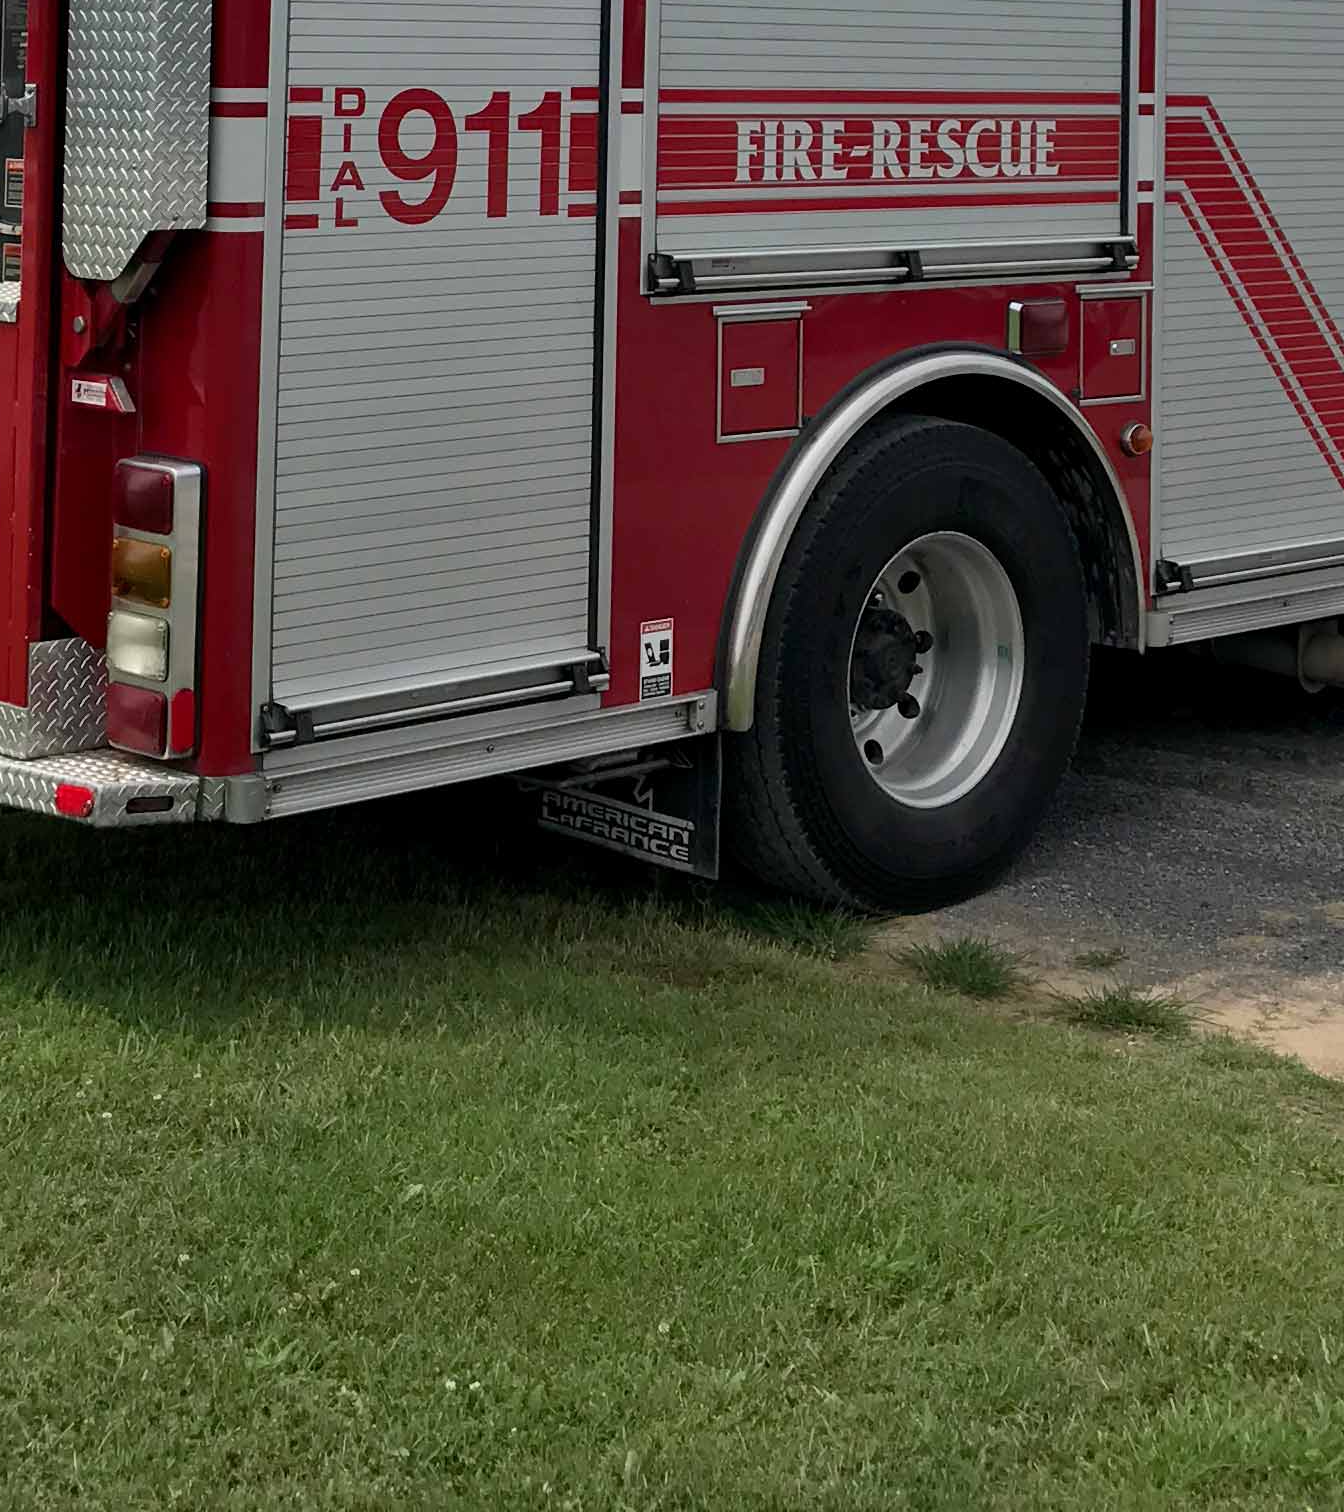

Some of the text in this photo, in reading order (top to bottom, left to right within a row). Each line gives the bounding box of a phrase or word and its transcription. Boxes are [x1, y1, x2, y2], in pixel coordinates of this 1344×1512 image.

[330, 87, 366, 228] DIAL
[378, 88, 562, 225] 911
[734, 119, 1060, 183] FIRE-RESCUE
[541, 790, 690, 845] AMERICAN
